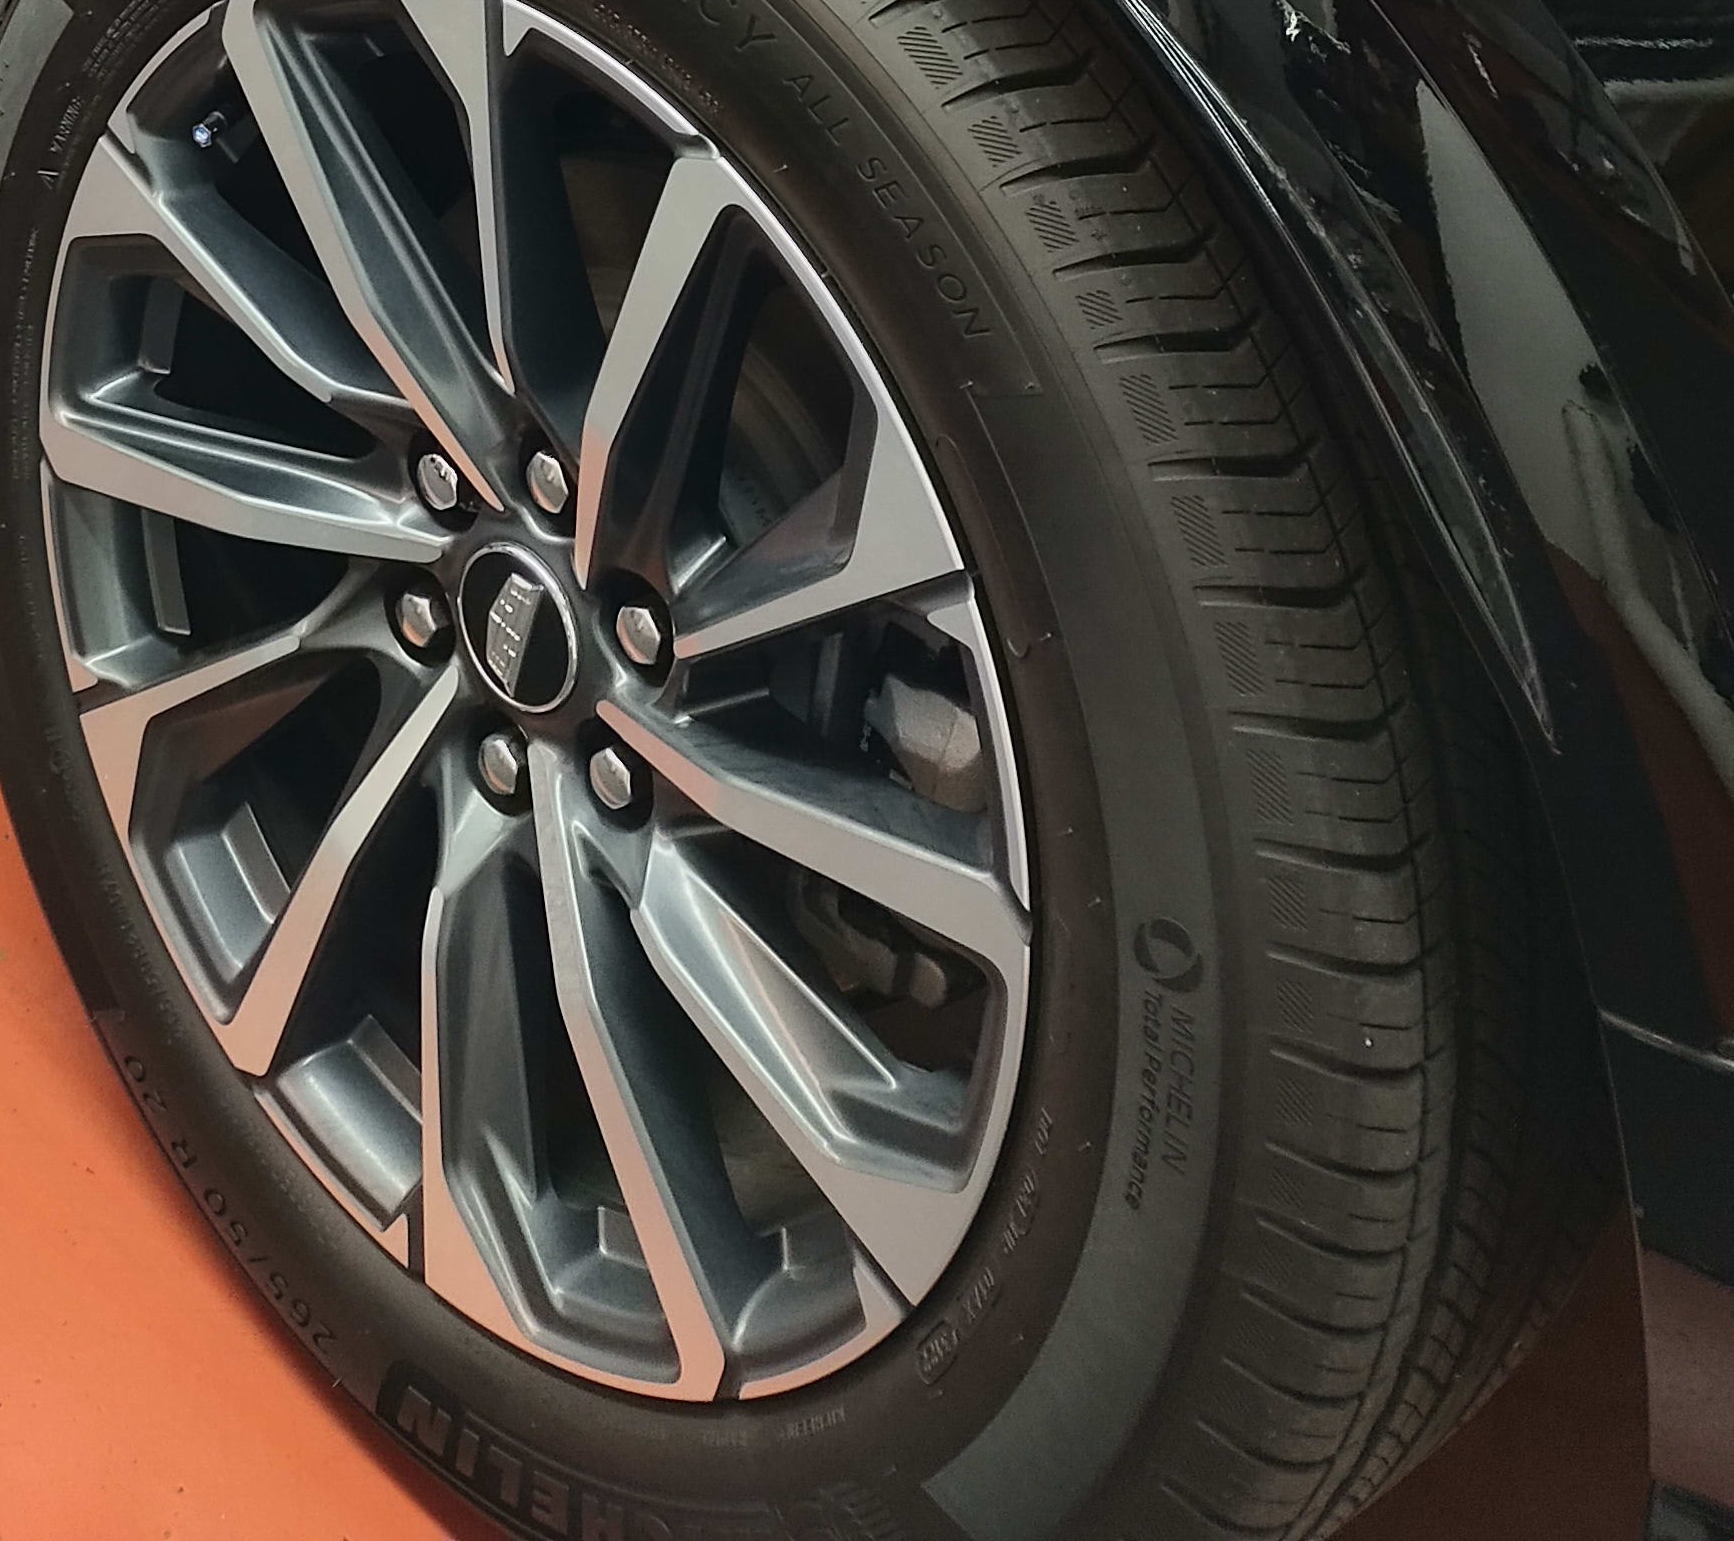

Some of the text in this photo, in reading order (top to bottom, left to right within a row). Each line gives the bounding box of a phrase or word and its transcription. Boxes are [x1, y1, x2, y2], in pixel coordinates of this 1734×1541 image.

[782, 73, 850, 148] ALL
[855, 156, 993, 339] SEASON
[122, 1054, 168, 1115] 20
[169, 1135, 199, 1170] R
[1124, 990, 1167, 1211] Total Performance
[1161, 1004, 1196, 1176] MICHELIN
[394, 1382, 696, 1541] HELIN
